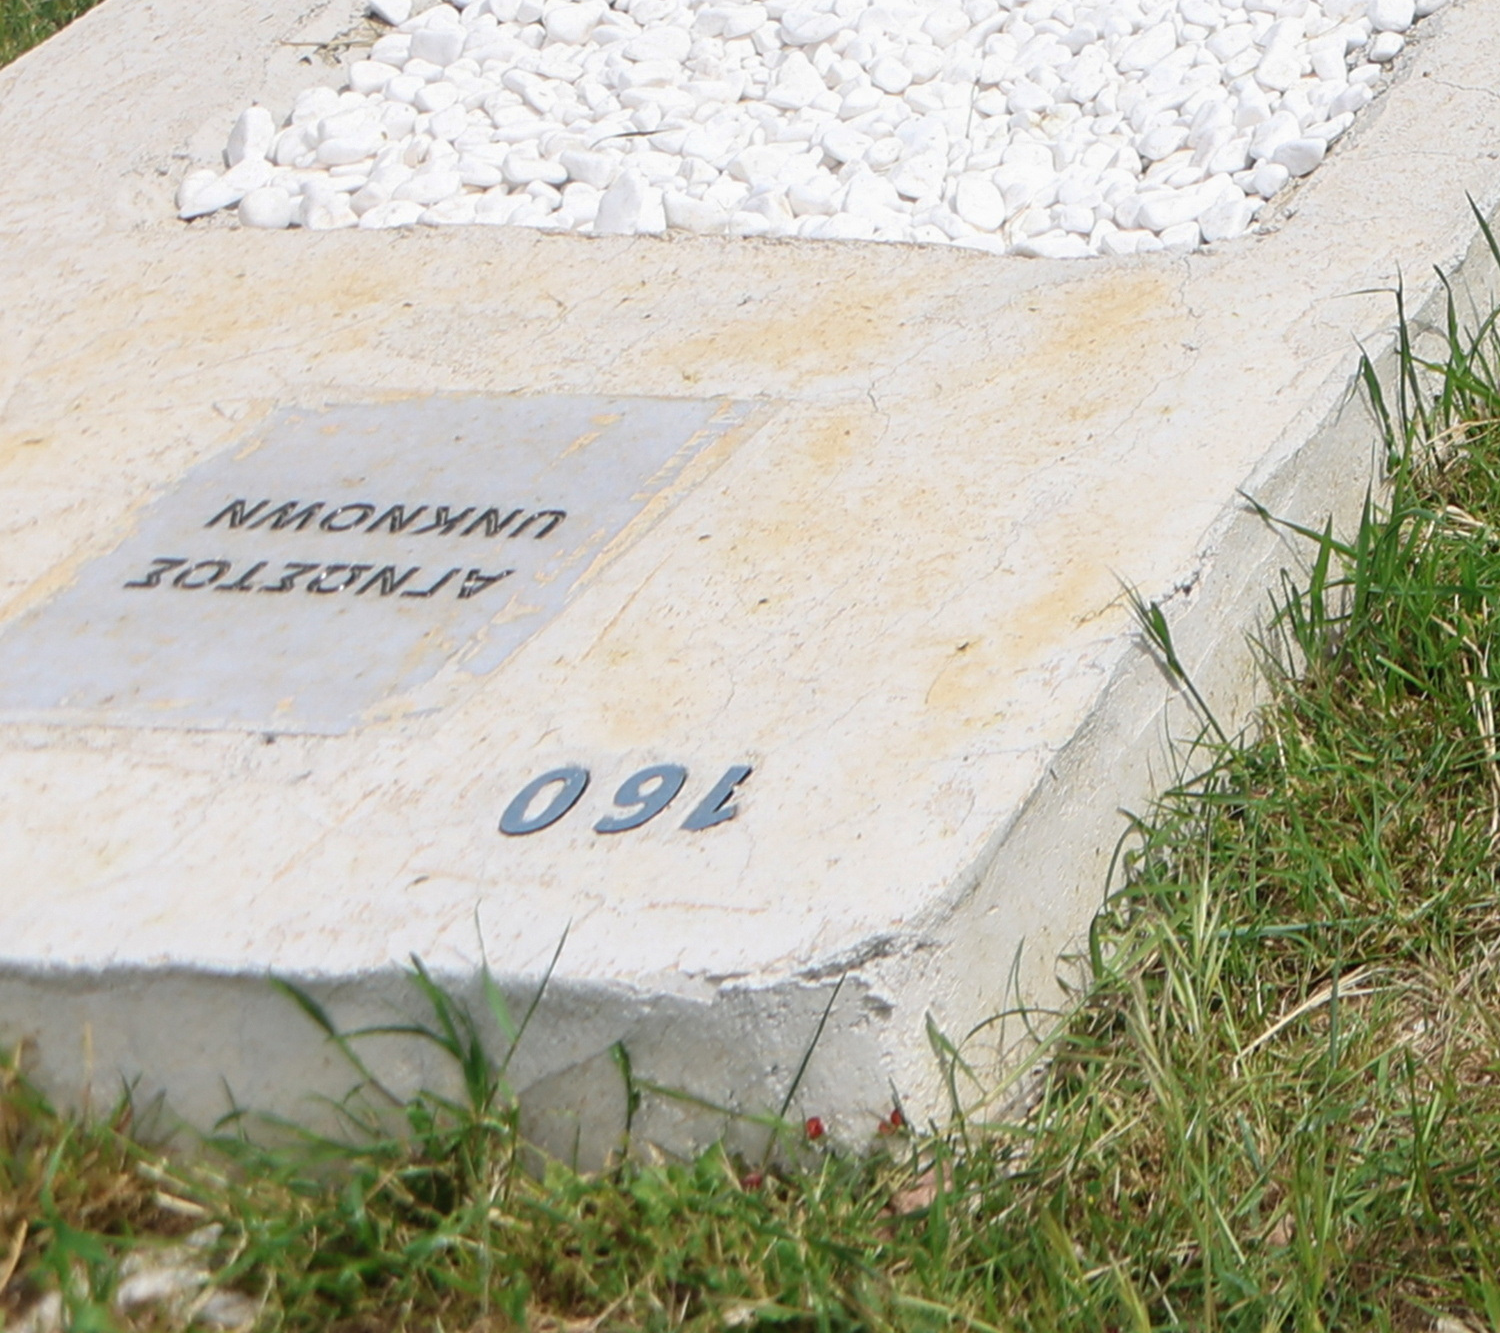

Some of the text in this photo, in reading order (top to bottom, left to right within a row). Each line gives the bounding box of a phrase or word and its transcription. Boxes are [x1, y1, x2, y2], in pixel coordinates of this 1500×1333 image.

[204, 499, 567, 540] UNKNOWN
[124, 556, 515, 600] ΑΓΝΩΣΤΟΣ
[497, 763, 753, 839] 160
